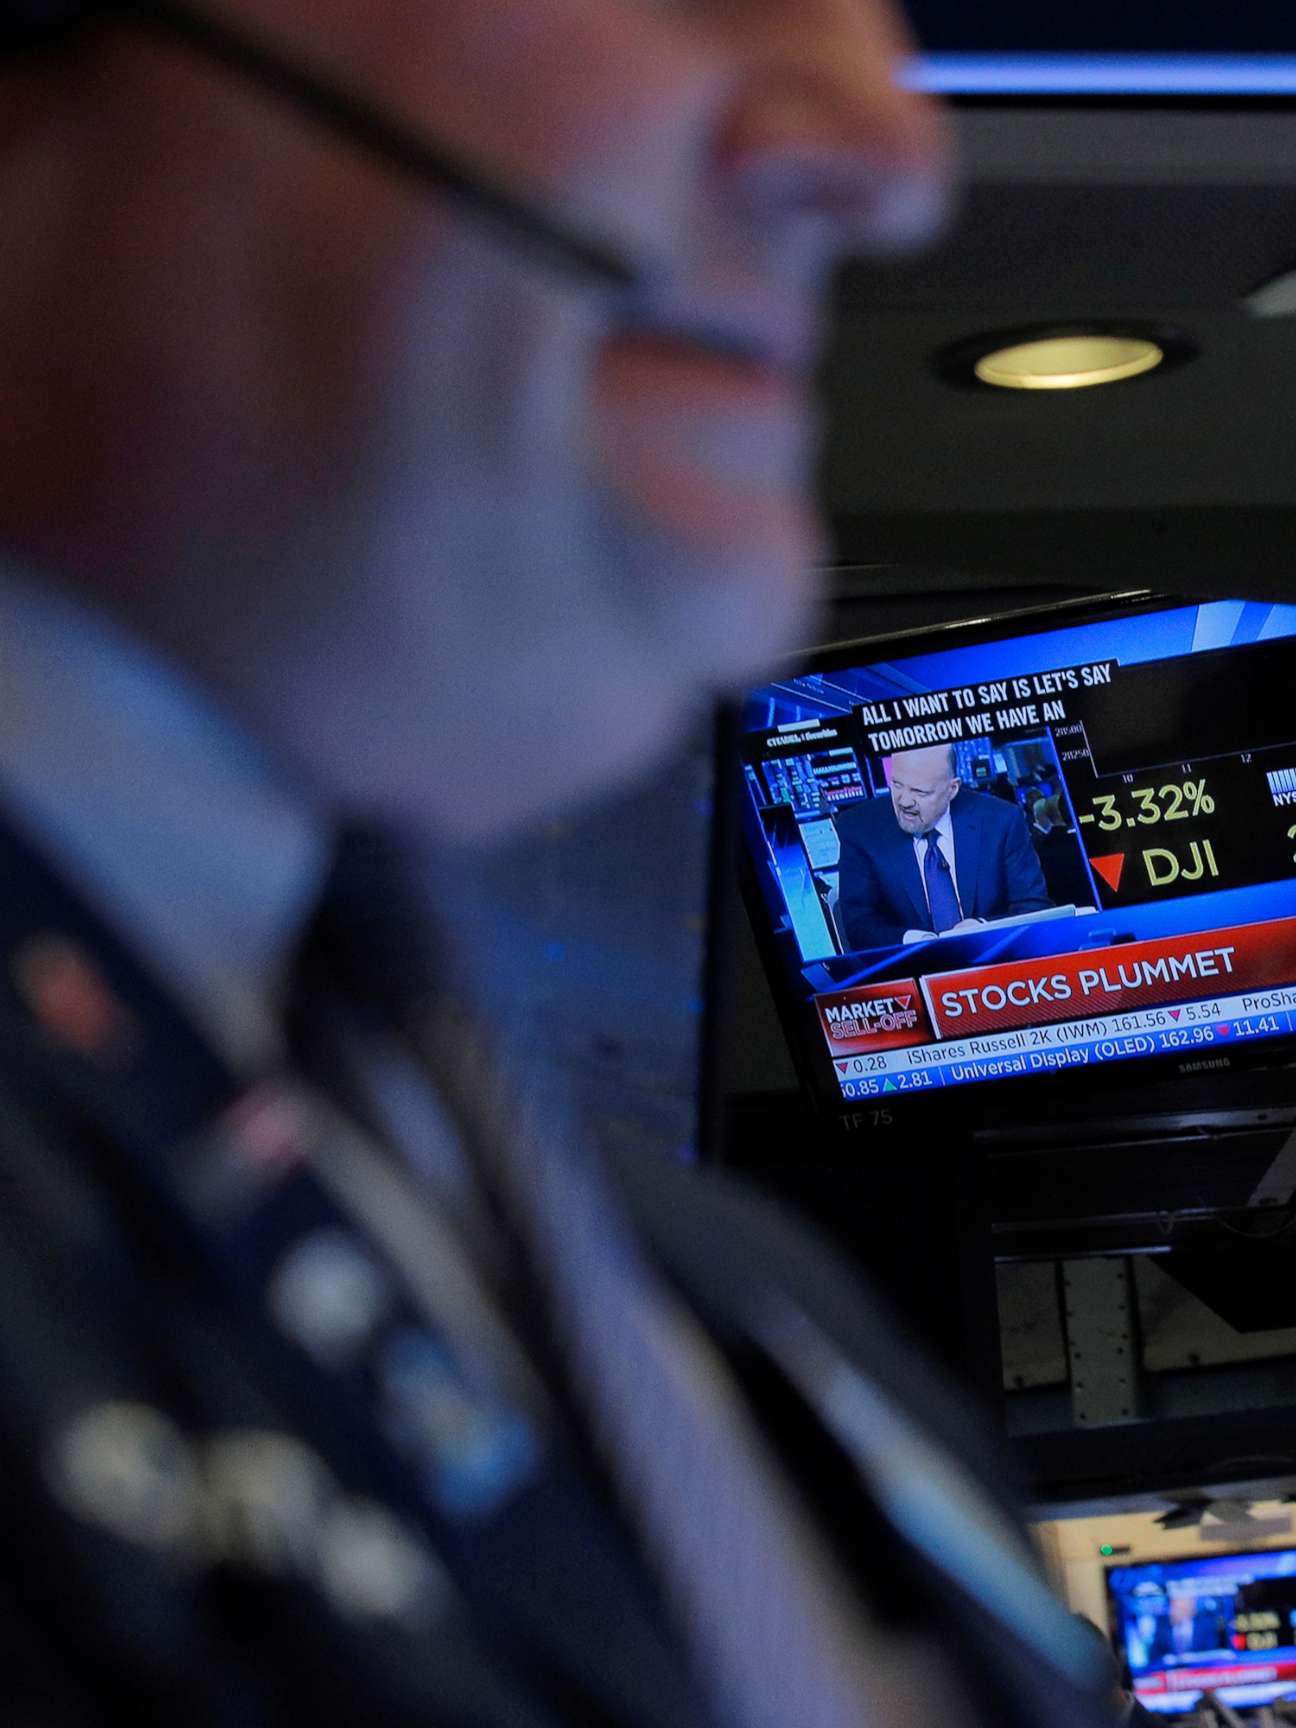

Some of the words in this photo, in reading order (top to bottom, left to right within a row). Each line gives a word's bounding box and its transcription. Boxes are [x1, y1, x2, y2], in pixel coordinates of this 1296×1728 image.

[862, 704, 892, 726] ALL
[895, 701, 902, 720] I
[903, 691, 950, 718] WANT
[952, 688, 976, 710] TO
[978, 682, 1008, 705] SAY
[1012, 679, 1031, 699] IS
[1034, 670, 1078, 696] LET'S
[1080, 663, 1113, 687] SAY
[868, 718, 964, 753] TOMORROW
[965, 711, 995, 736] WE
[998, 704, 1042, 731] HAVE
[1043, 700, 1067, 723] AN
[1078, 778, 1216, 831] -3.32%
[1142, 839, 1219, 887] DJI
[940, 974, 1073, 1018] STOCKS
[1080, 946, 1235, 996] PLUMMET
[824, 998, 895, 1023] MARKET
[829, 1009, 919, 1040] SELL-OFF
[852, 1055, 887, 1073] 0.28
[907, 1046, 966, 1065] iShares
[969, 1033, 1027, 1055] Russell
[1029, 1026, 1052, 1043] 2K
[1056, 1019, 1108, 1043] (IWM)
[1113, 1009, 1167, 1033] 161.56
[1186, 1001, 1221, 1021] 5.54
[840, 1079, 879, 1099] 0.85
[899, 1071, 933, 1090] 2.81
[951, 1055, 1027, 1082] Universal
[1030, 1046, 1090, 1069] Display
[1095, 1036, 1156, 1062] (OLED)
[1159, 1026, 1215, 1050] 162.96
[1233, 1015, 1280, 1037] 11.41
[1178, 1057, 1231, 1073] SAMSUNG
[839, 1113, 865, 1131] TF
[871, 1107, 893, 1125] 75
